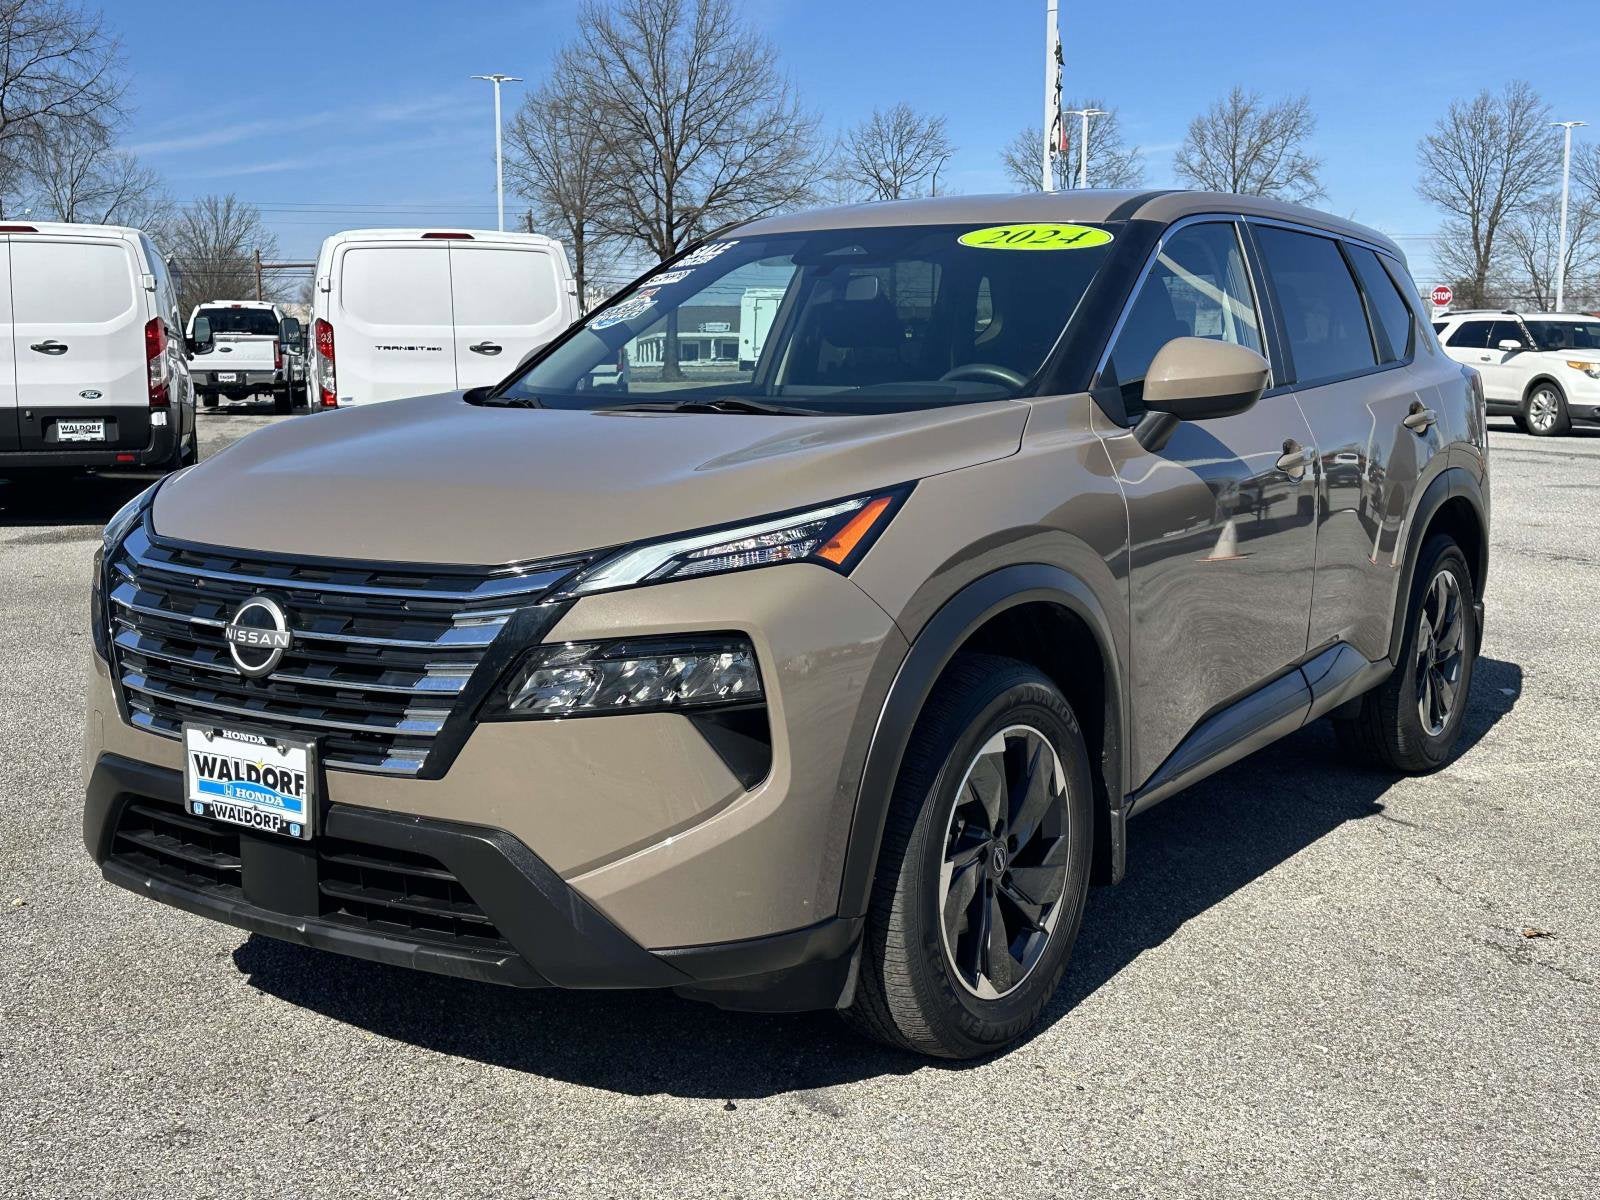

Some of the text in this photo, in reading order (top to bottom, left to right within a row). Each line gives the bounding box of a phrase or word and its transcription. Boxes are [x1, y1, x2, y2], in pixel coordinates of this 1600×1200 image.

[978, 230, 1092, 245] 2024
[1432, 291, 1451, 301] STOP
[225, 627, 288, 646] NISSAN
[222, 729, 268, 745] HONDA
[193, 753, 305, 797] WALDORF
[235, 788, 286, 807] HONDA
[213, 801, 281, 831] WALDORF
